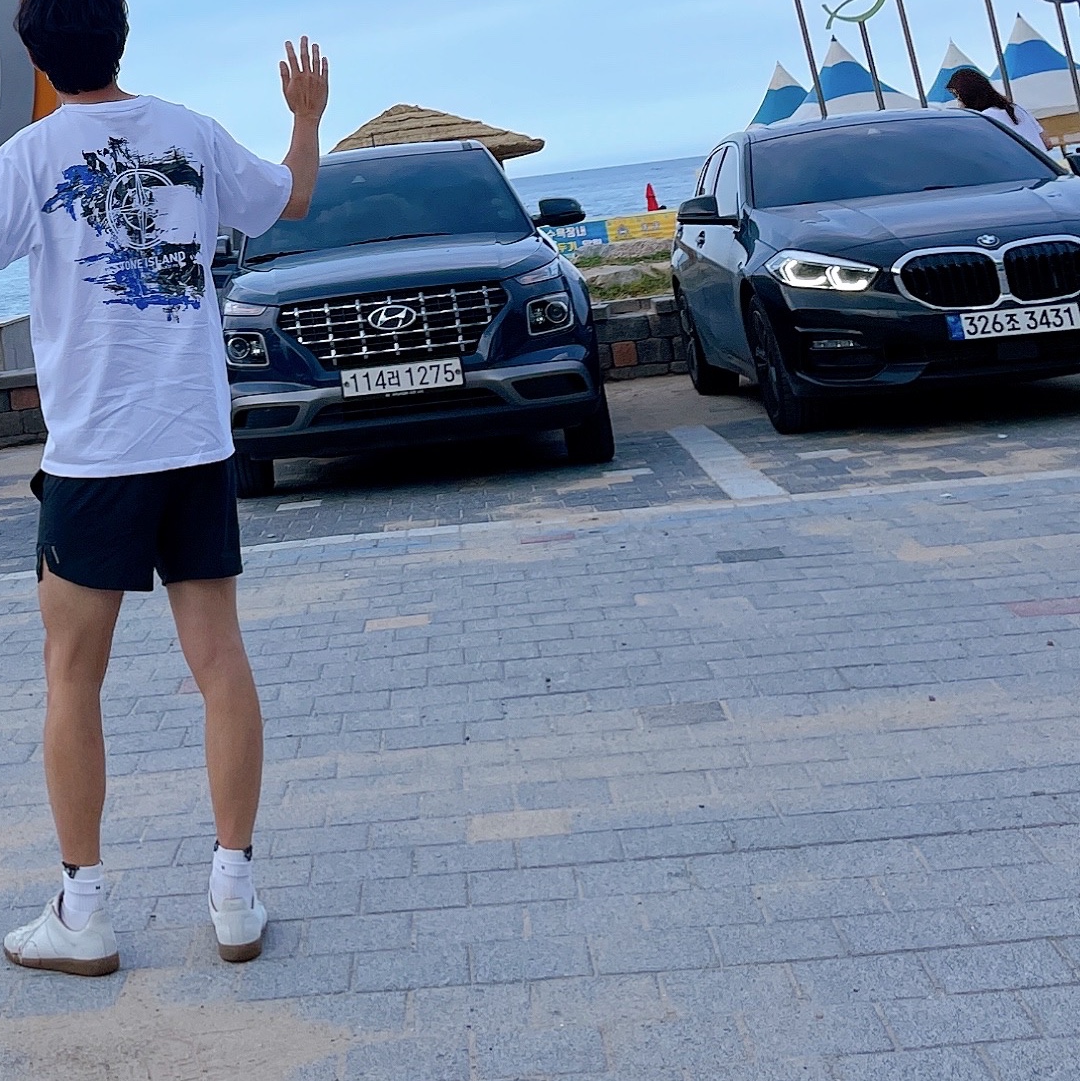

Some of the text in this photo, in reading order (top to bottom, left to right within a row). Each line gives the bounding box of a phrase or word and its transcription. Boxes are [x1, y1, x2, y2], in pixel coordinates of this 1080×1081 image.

[145, 251, 186, 268] ISLAND
[964, 306, 1075, 336] 326조 3431
[350, 363, 456, 393] 114러 1275
